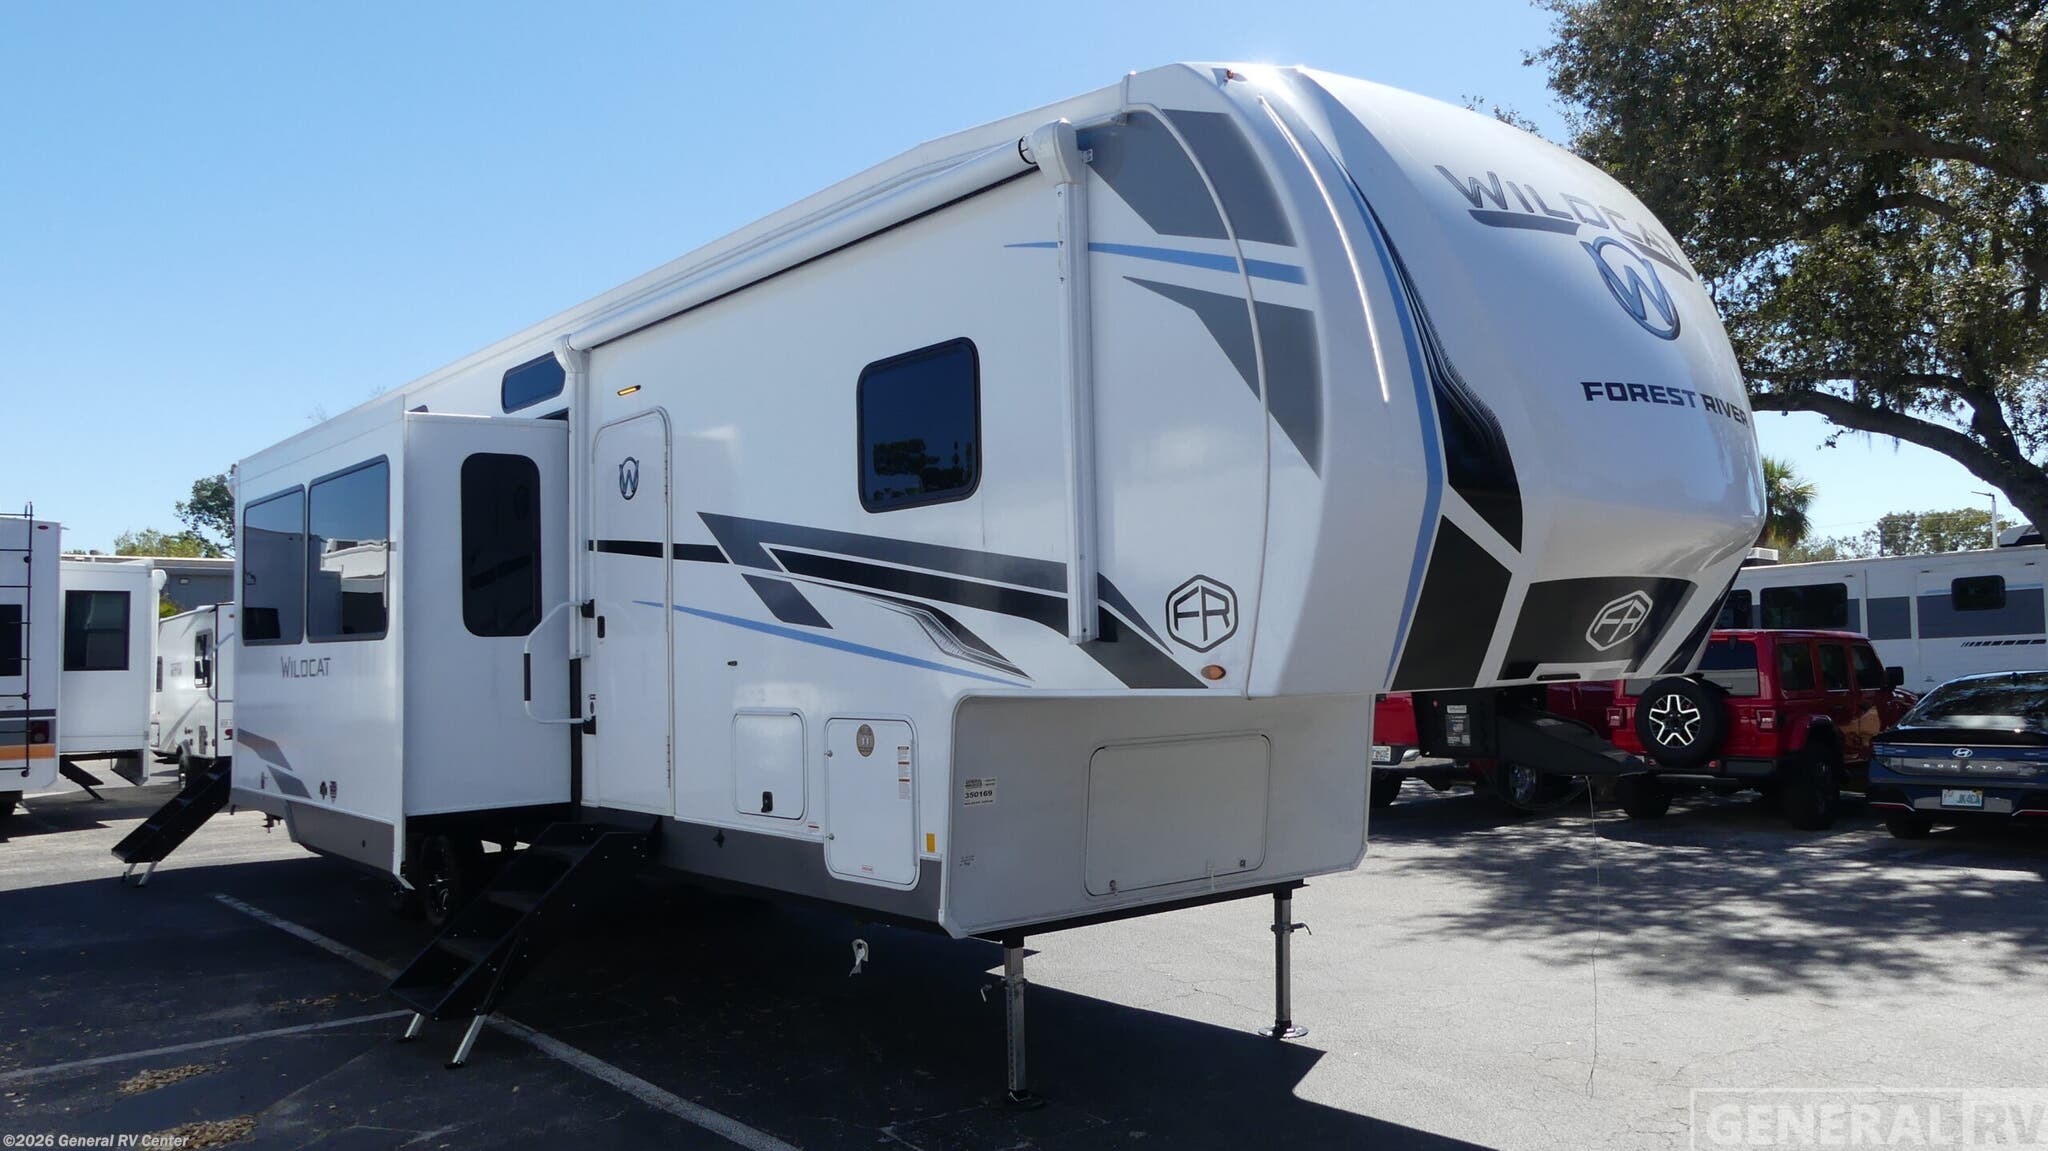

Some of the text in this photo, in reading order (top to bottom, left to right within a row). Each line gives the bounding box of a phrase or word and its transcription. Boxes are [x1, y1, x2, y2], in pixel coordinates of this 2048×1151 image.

[1435, 165, 1683, 266] WILDCAT
[1581, 381, 1749, 426] FOREST RIVER
[280, 656, 331, 679] WILDCAT
[964, 789, 993, 799] 350169
